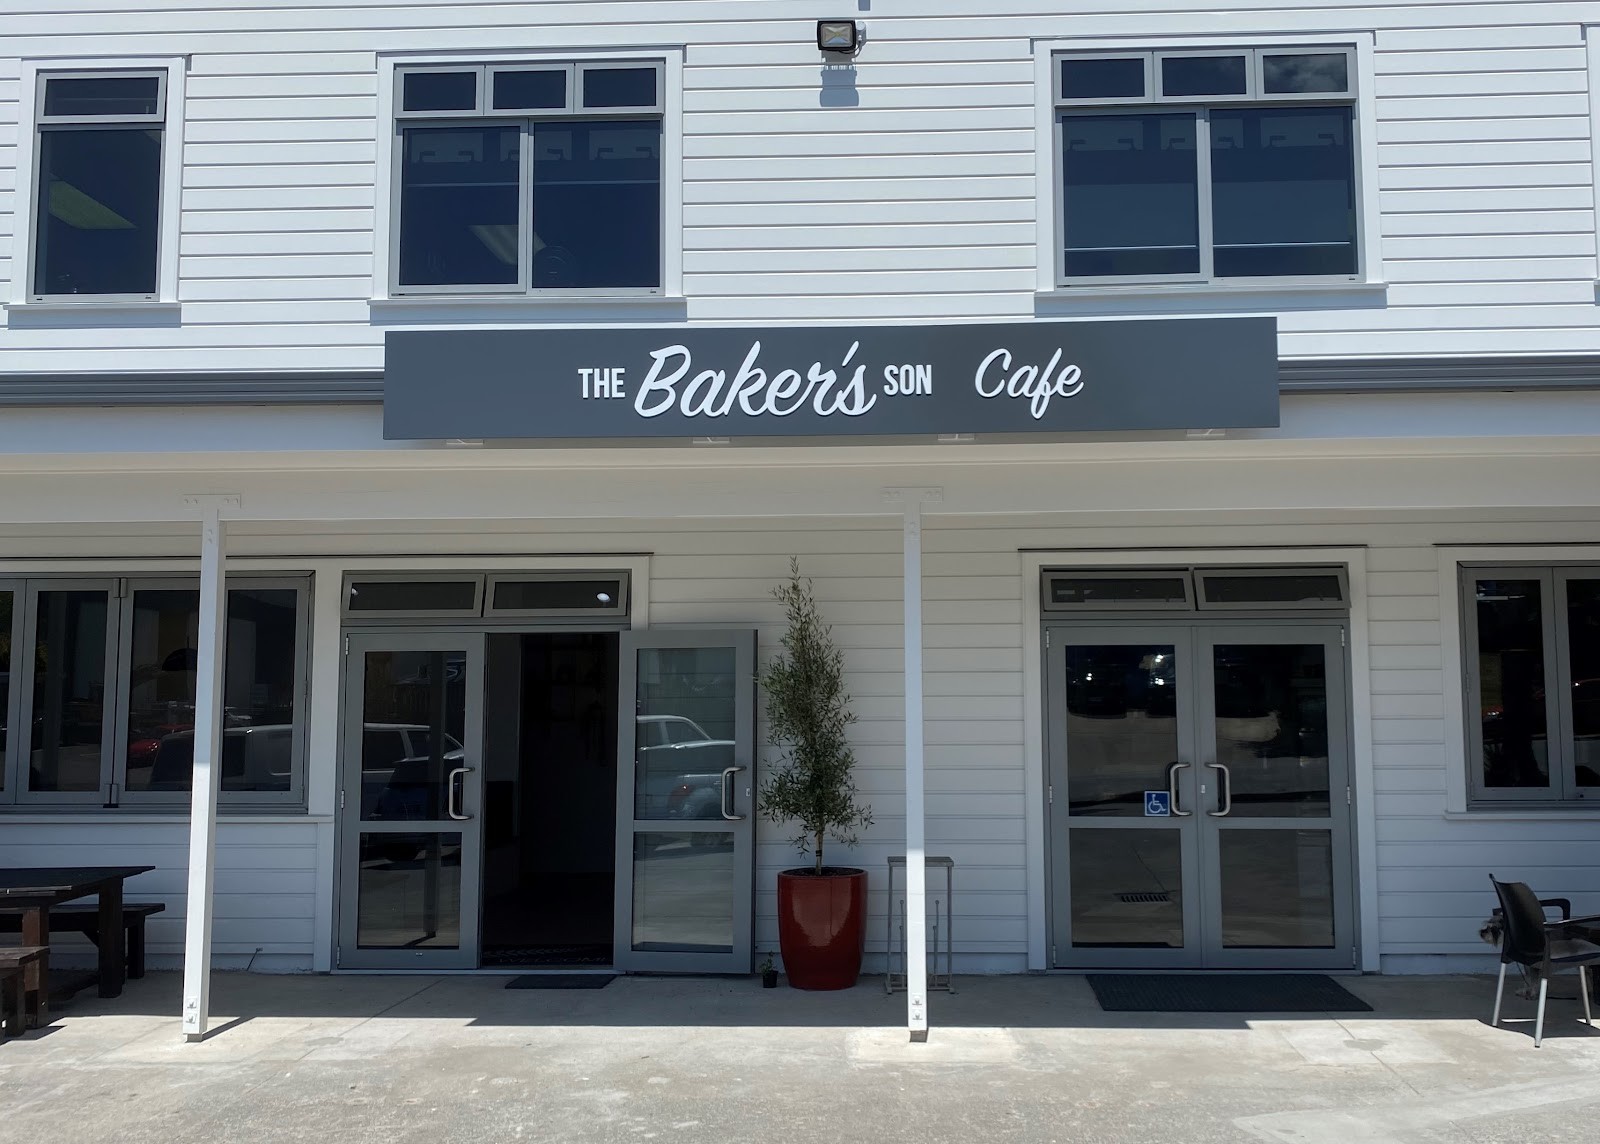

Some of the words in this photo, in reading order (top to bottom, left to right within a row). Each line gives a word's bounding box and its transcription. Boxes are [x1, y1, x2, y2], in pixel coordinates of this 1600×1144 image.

[577, 368, 626, 399] THE
[634, 340, 877, 417] Baker's
[883, 364, 932, 397] SON
[975, 347, 1085, 419] Cafe
